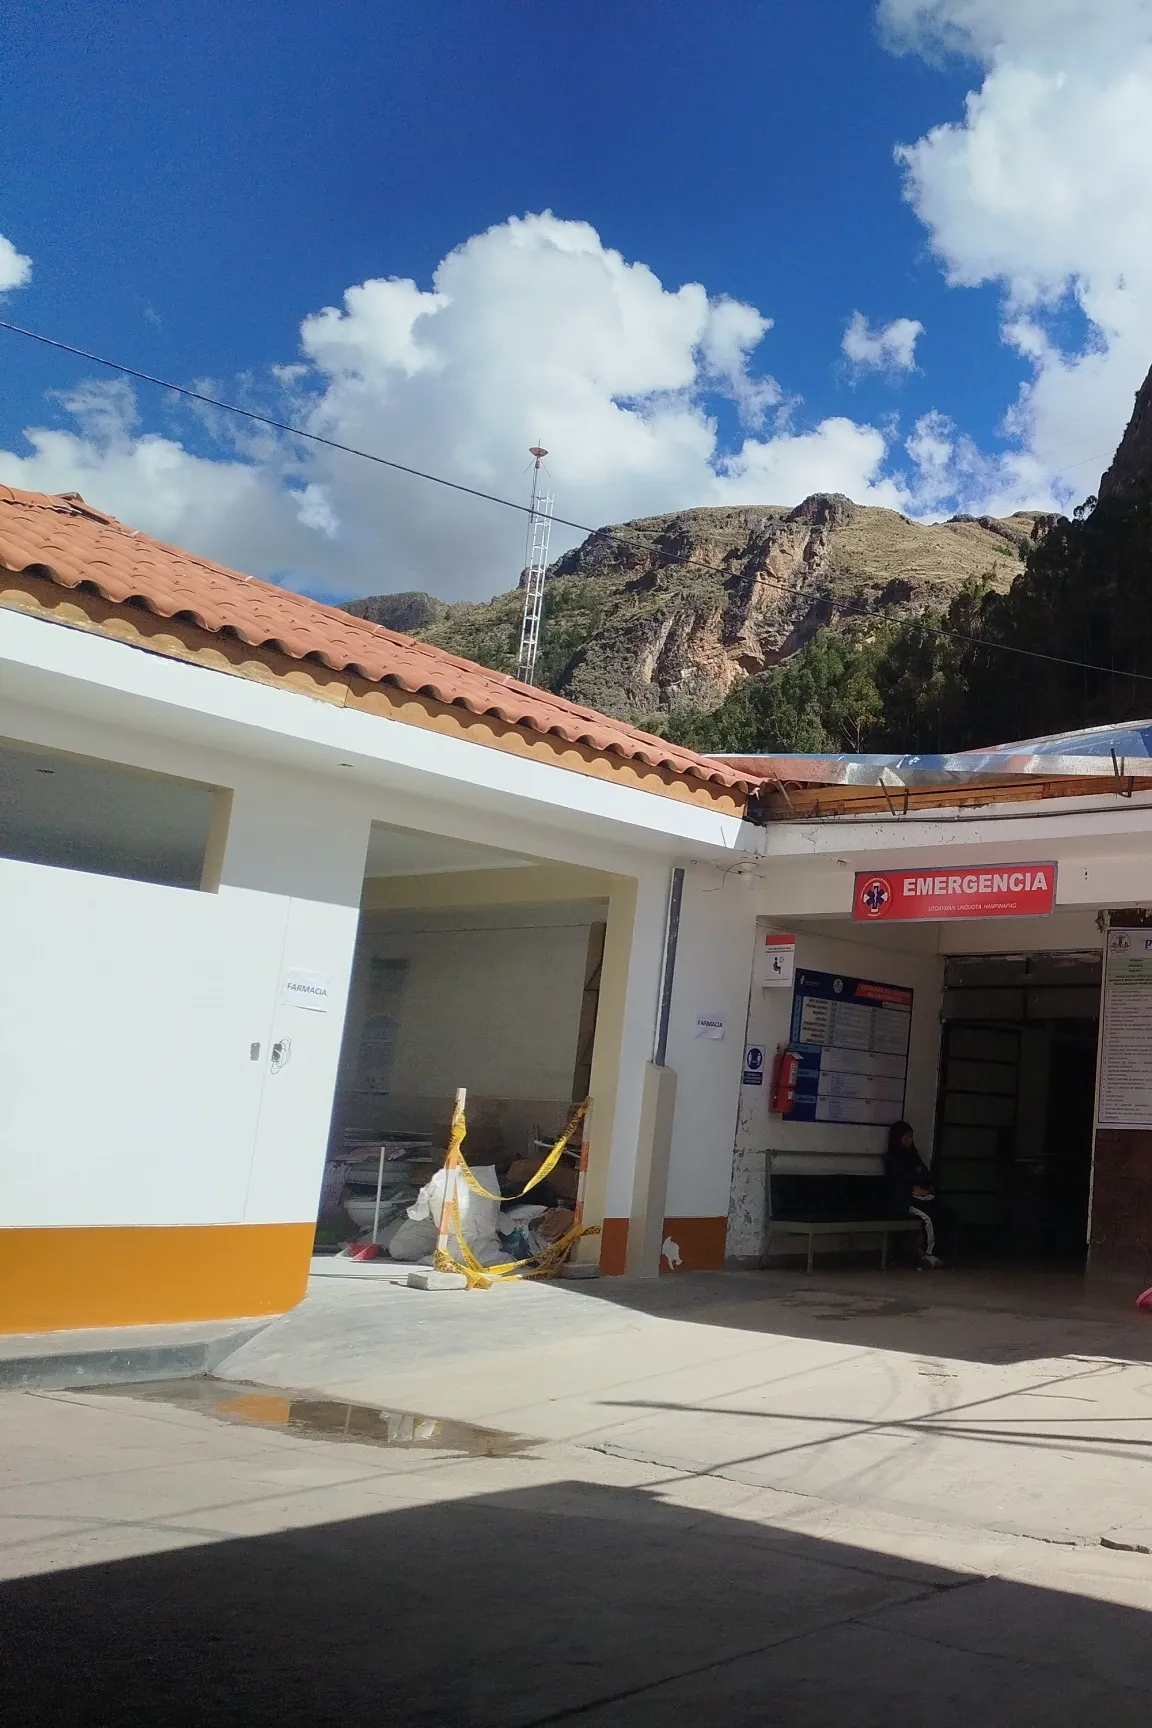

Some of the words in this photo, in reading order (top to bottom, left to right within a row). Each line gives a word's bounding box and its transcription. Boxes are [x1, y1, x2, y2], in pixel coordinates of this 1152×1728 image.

[902, 871, 1048, 896] EMERGENCIA
[287, 983, 327, 996] FARMACIA
[697, 1019, 723, 1028] FARMACIA
